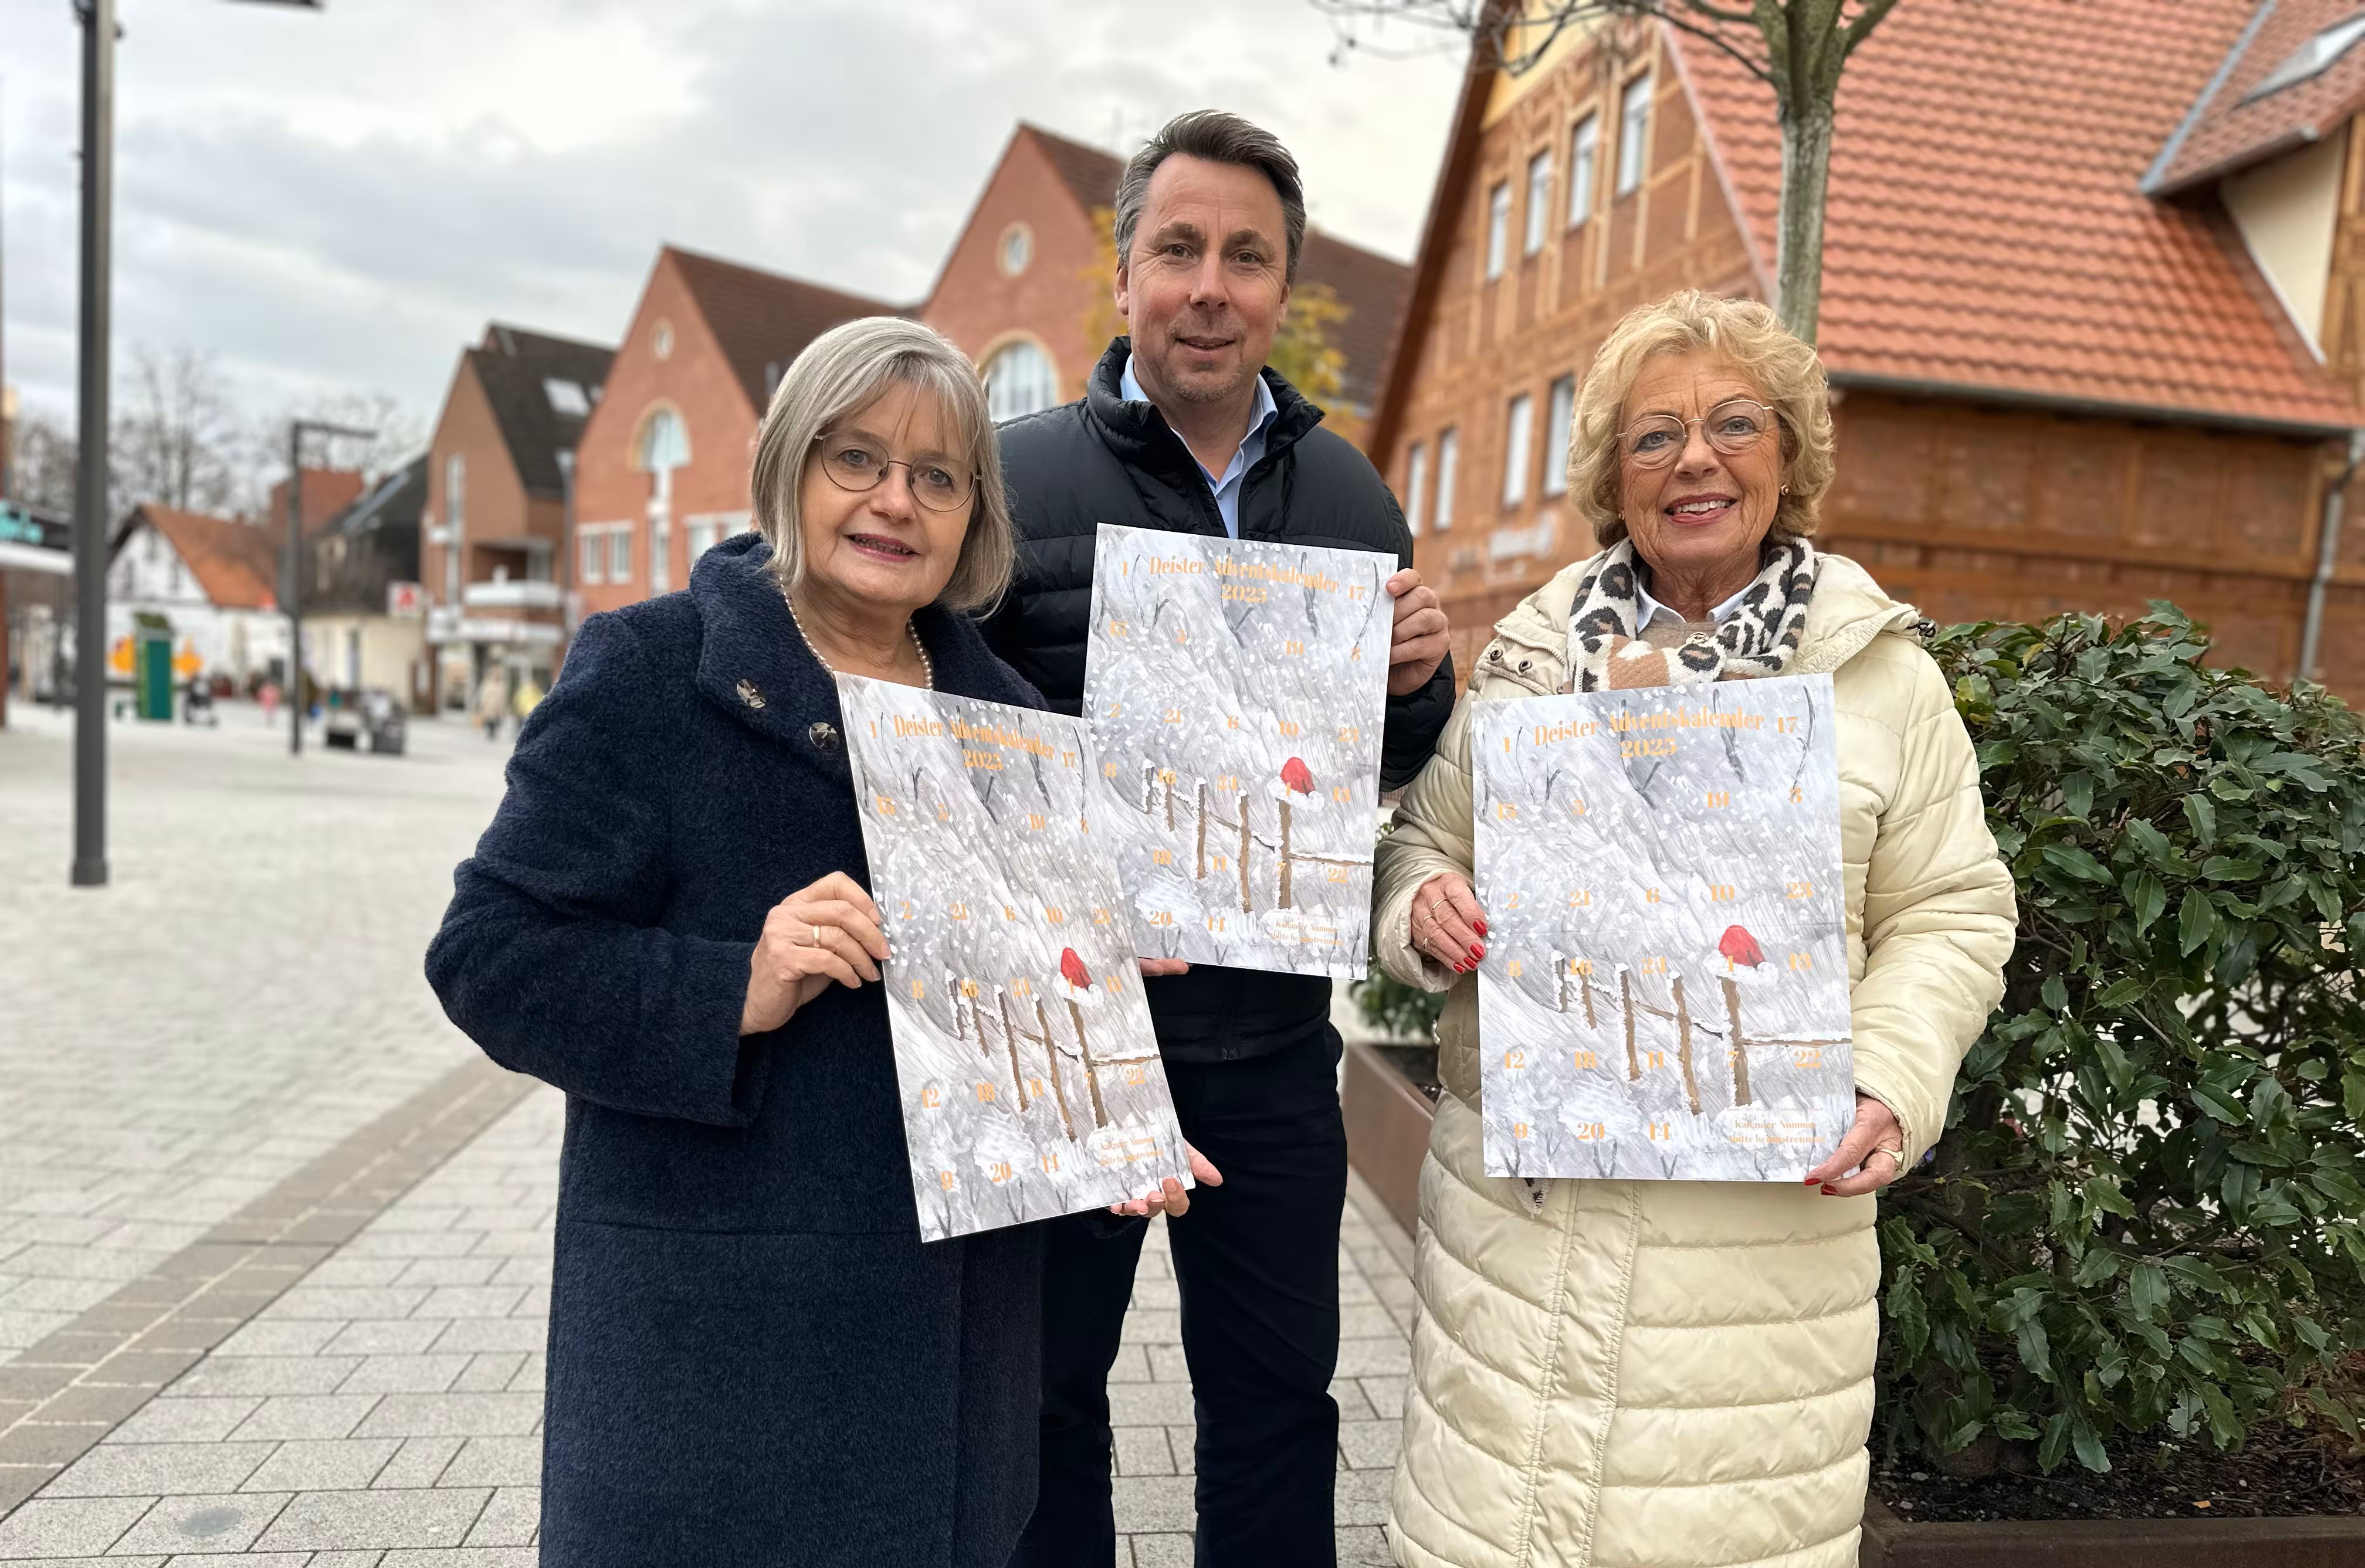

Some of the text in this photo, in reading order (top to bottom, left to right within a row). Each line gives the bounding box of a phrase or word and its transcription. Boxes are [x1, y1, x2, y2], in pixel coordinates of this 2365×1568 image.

[1150, 555, 1339, 593] Deister Adventskalender
[1221, 584, 1267, 603] 2025
[893, 715, 1055, 760] Deister Adventskalender
[1534, 705, 1764, 746] Deister Adventskalender
[961, 750, 1003, 770] 2025
[1620, 738, 1677, 758] 2025
